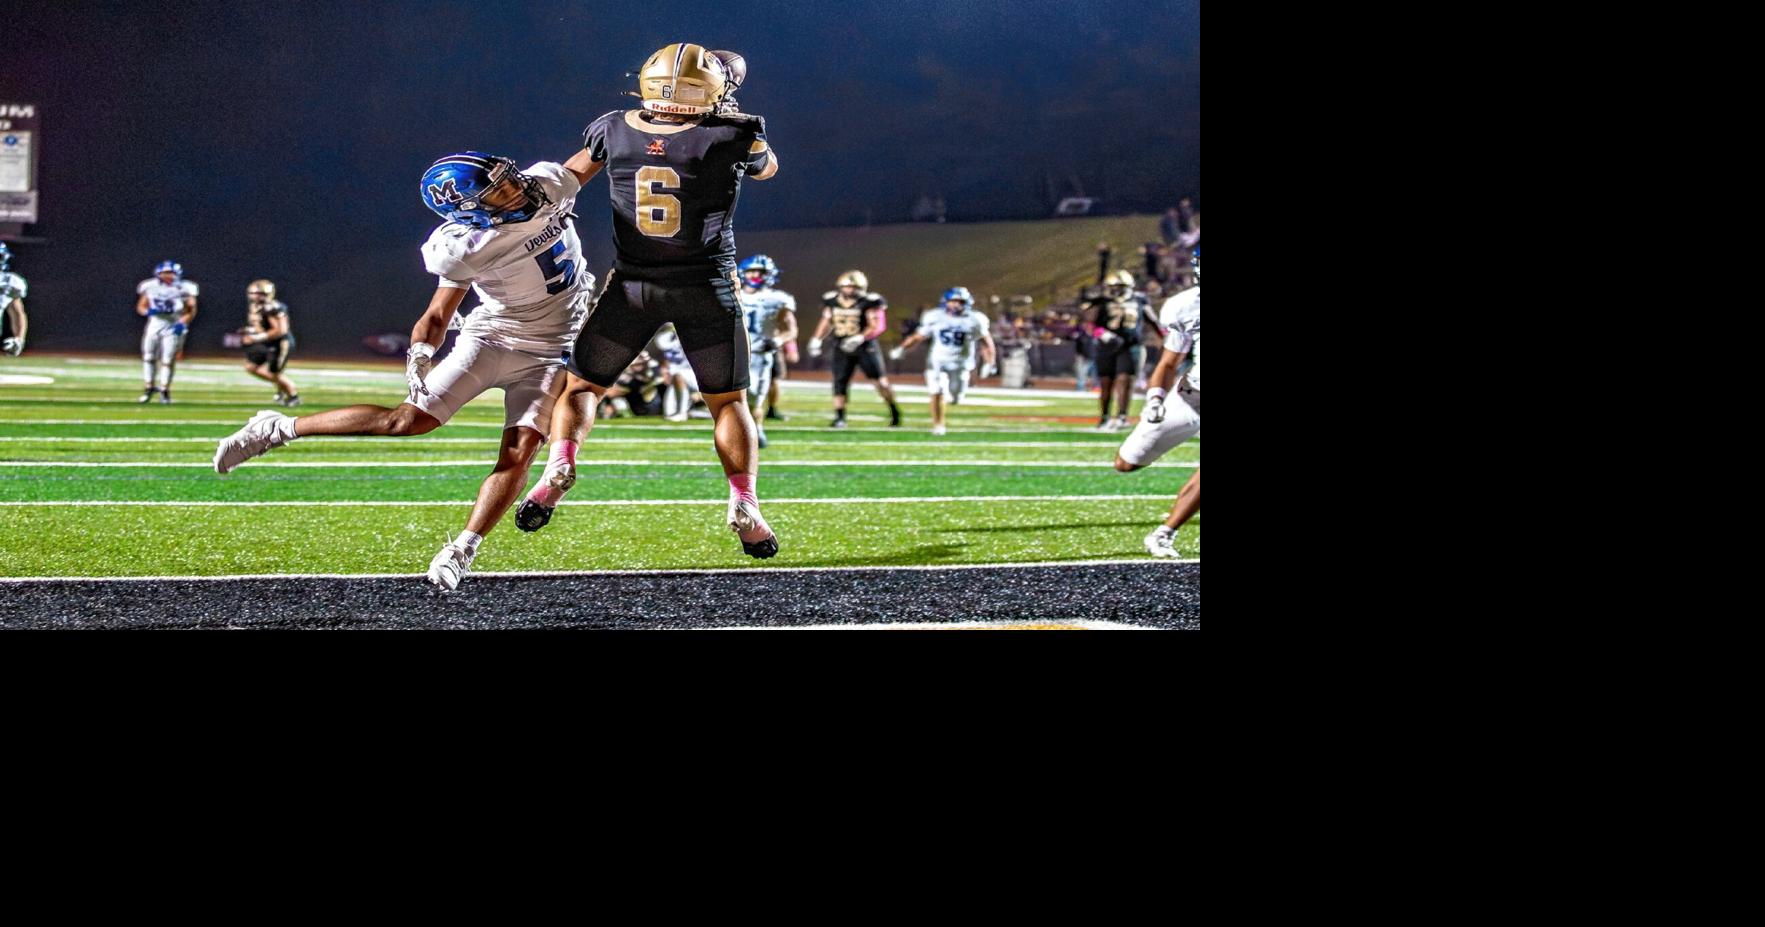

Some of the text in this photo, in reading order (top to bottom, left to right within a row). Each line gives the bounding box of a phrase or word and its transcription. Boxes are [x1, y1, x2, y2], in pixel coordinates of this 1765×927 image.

[661, 84, 673, 99] 6
[652, 103, 697, 113] Riddell
[428, 178, 463, 207] M
[635, 165, 681, 238] 6
[534, 239, 576, 296] 5
